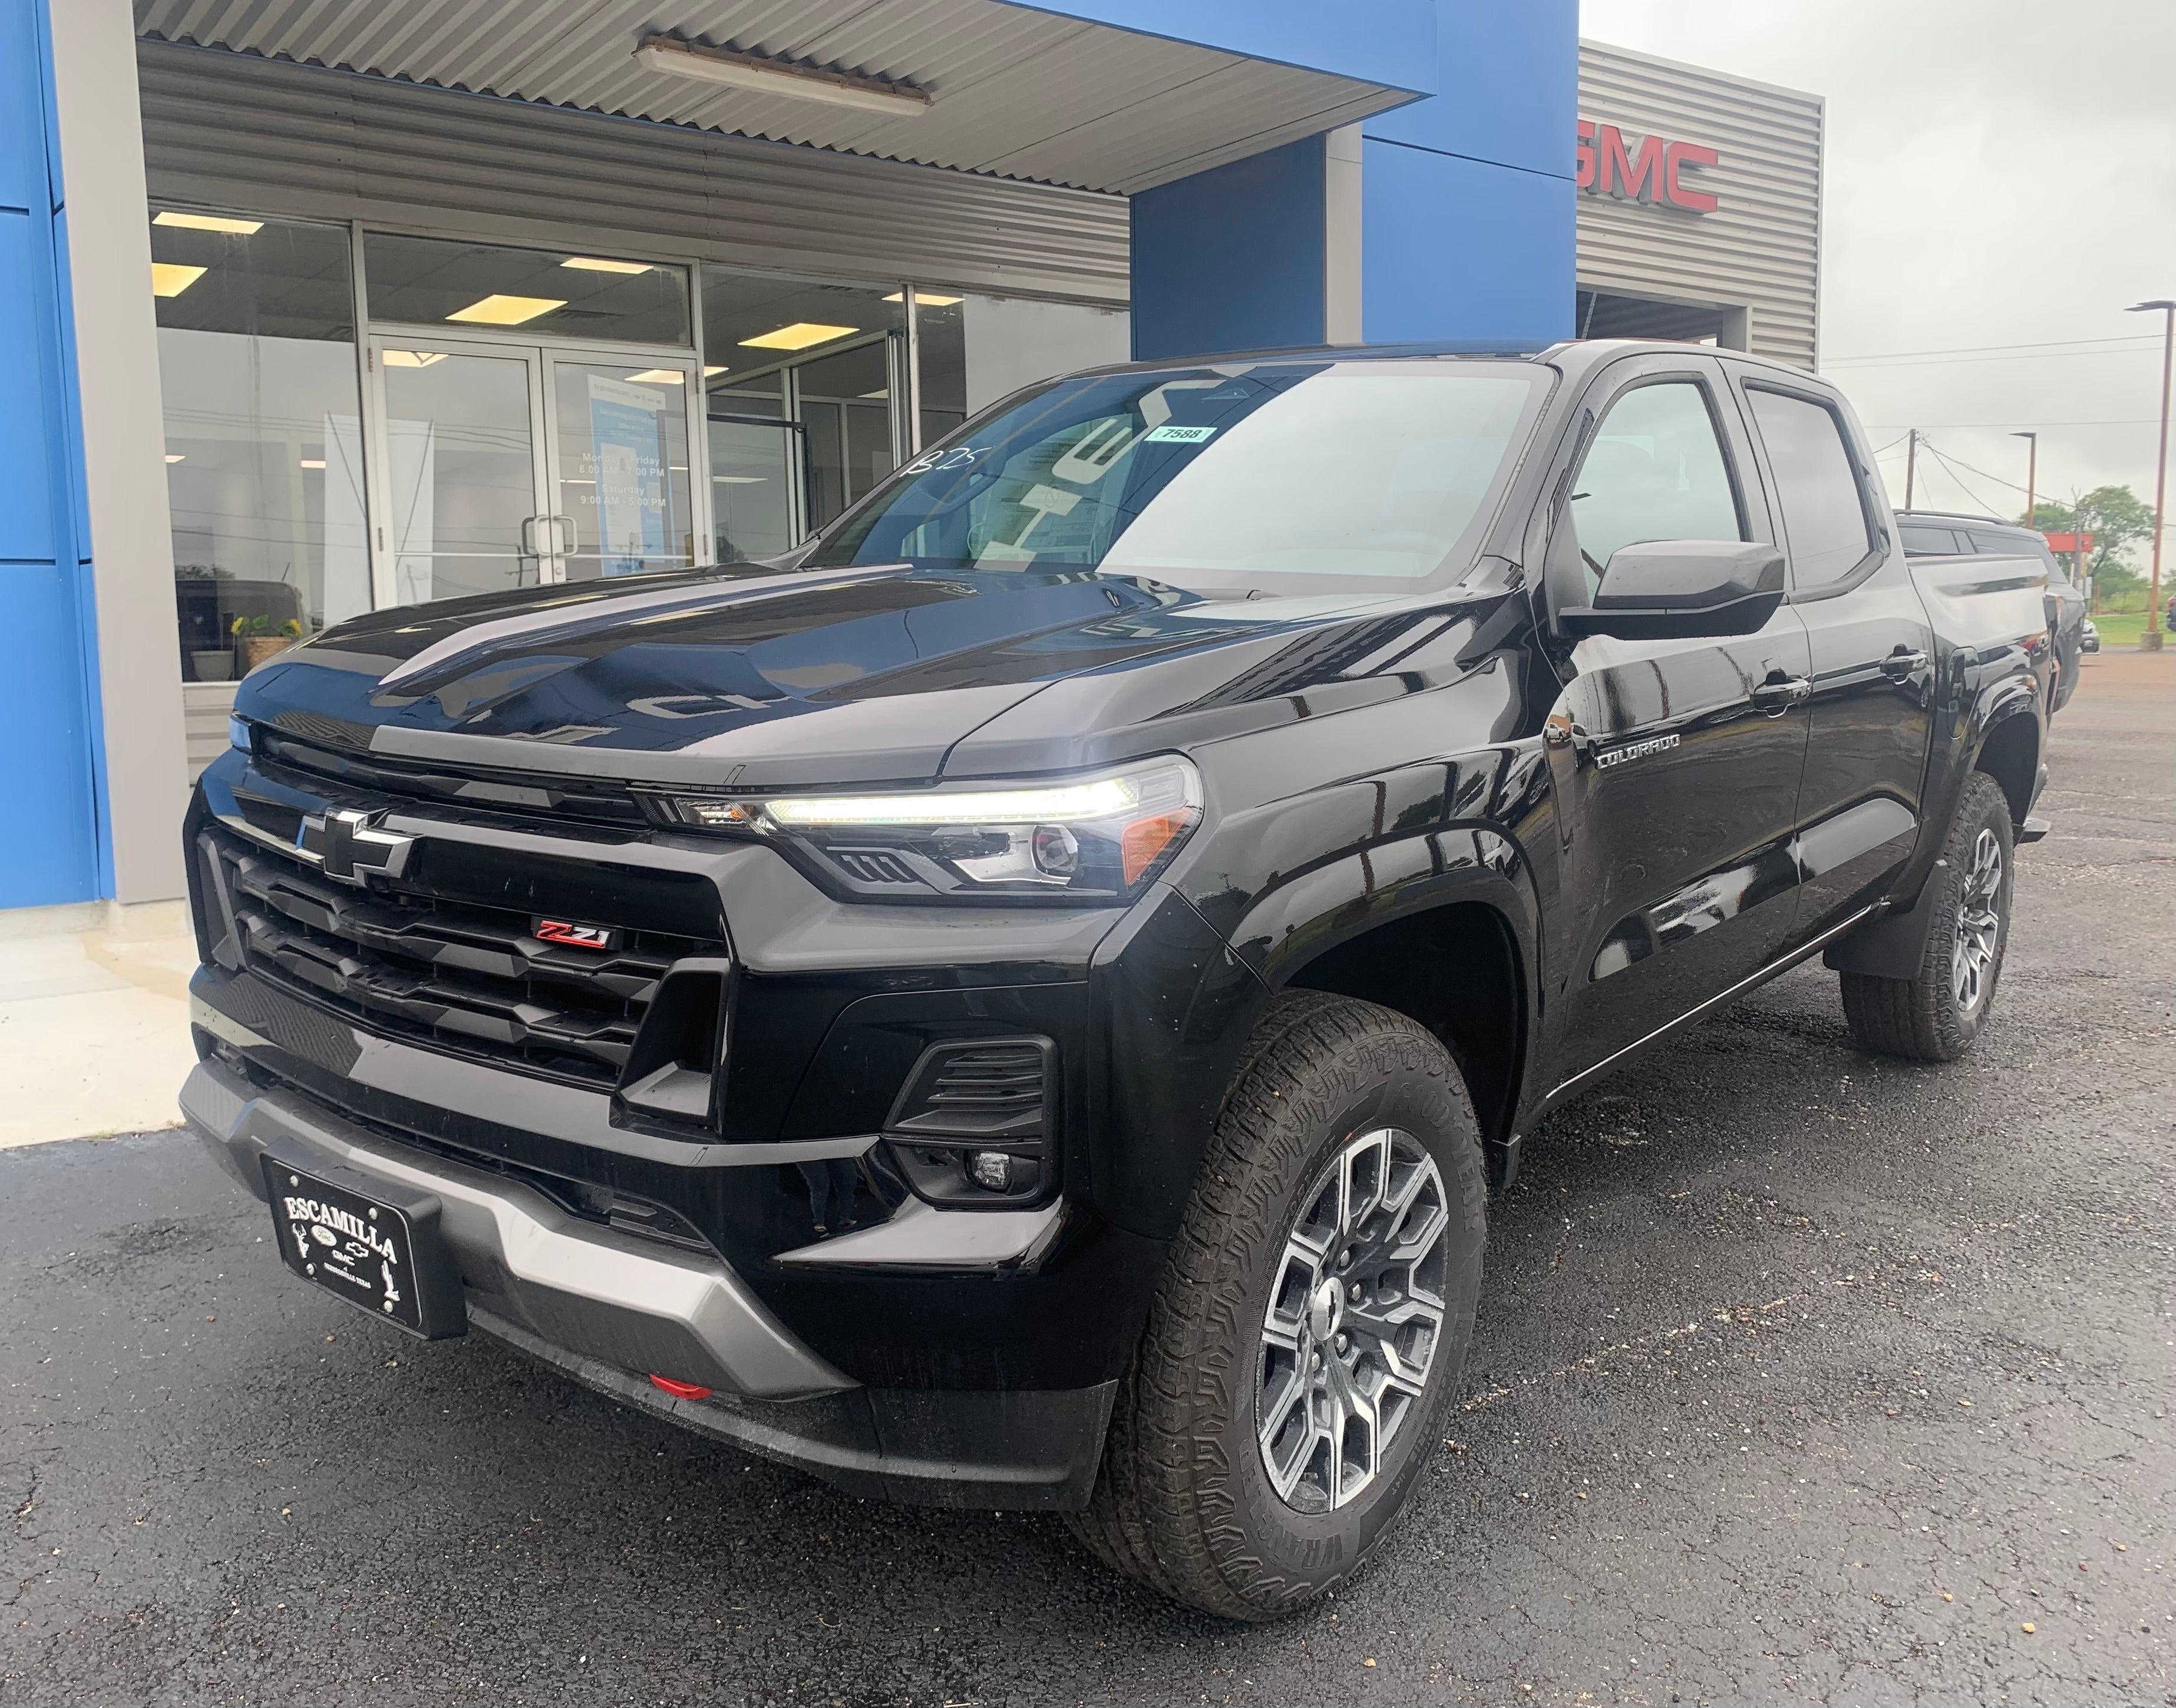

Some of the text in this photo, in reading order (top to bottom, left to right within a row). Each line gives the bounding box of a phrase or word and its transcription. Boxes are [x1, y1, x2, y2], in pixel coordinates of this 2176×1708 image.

[1162, 429, 1203, 438] 7588
[583, 452, 620, 466] Monday
[630, 455, 660, 467] Friday
[579, 464, 599, 474] 8:00
[650, 468, 665, 477] PM
[602, 484, 645, 496] Saturday
[580, 495, 601, 504] 9:00
[604, 497, 619, 505] AM
[628, 497, 648, 506] 5:00
[651, 498, 666, 507] PM
[1596, 734, 1680, 768] COLORADO
[536, 920, 610, 949] Z71
[284, 1197, 397, 1264] ESCAMILLA
[332, 1249, 355, 1266] GMC
